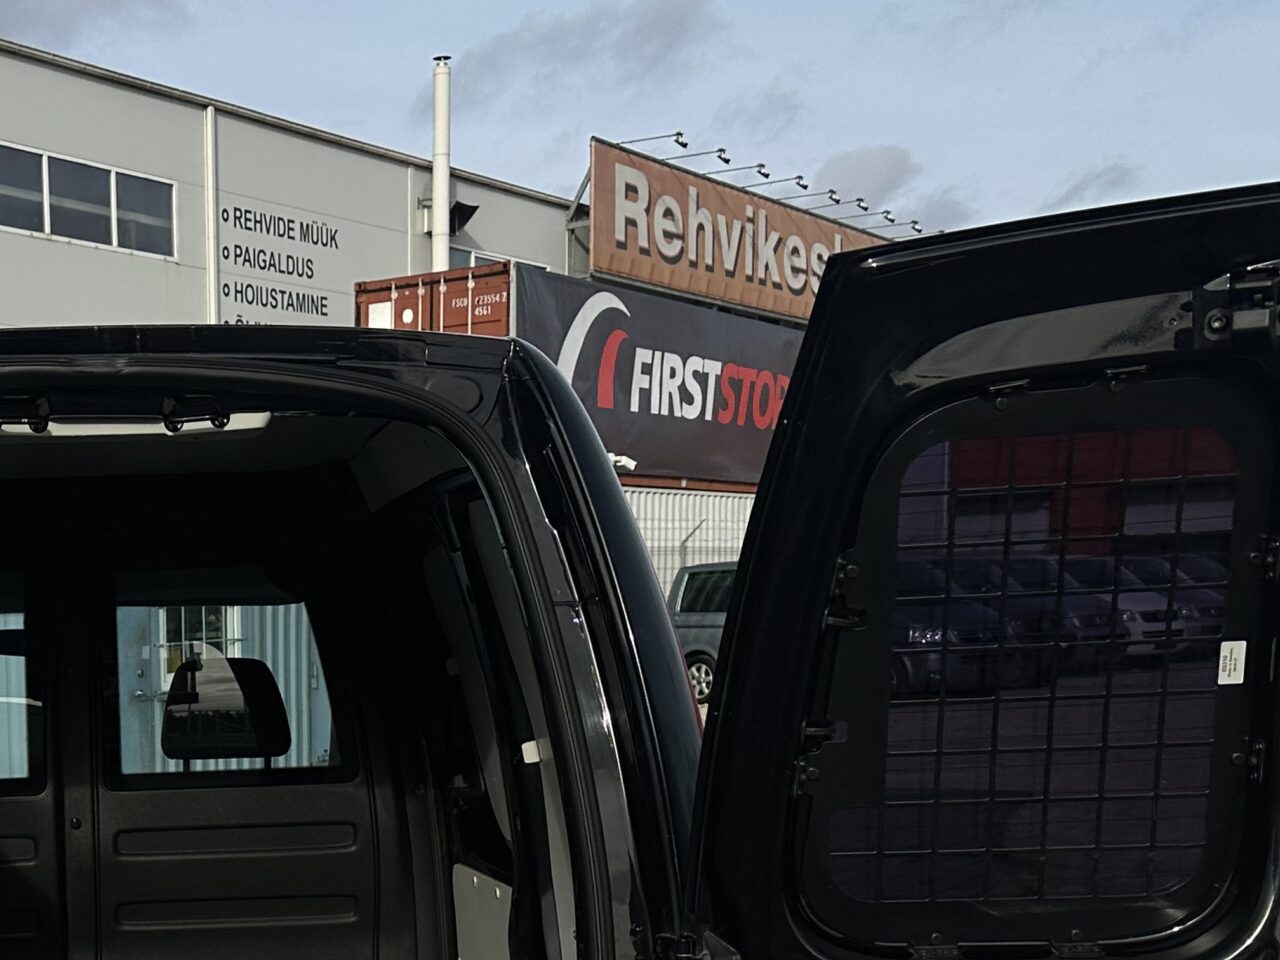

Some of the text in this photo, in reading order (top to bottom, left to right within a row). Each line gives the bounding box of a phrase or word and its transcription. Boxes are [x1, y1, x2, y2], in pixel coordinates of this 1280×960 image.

[233, 206, 339, 249] REHVIDE MÜÜK
[614, 162, 842, 296] Rehvikes
[233, 244, 314, 279] PAIGALDUS
[234, 281, 329, 317] HOIUSTAMINE
